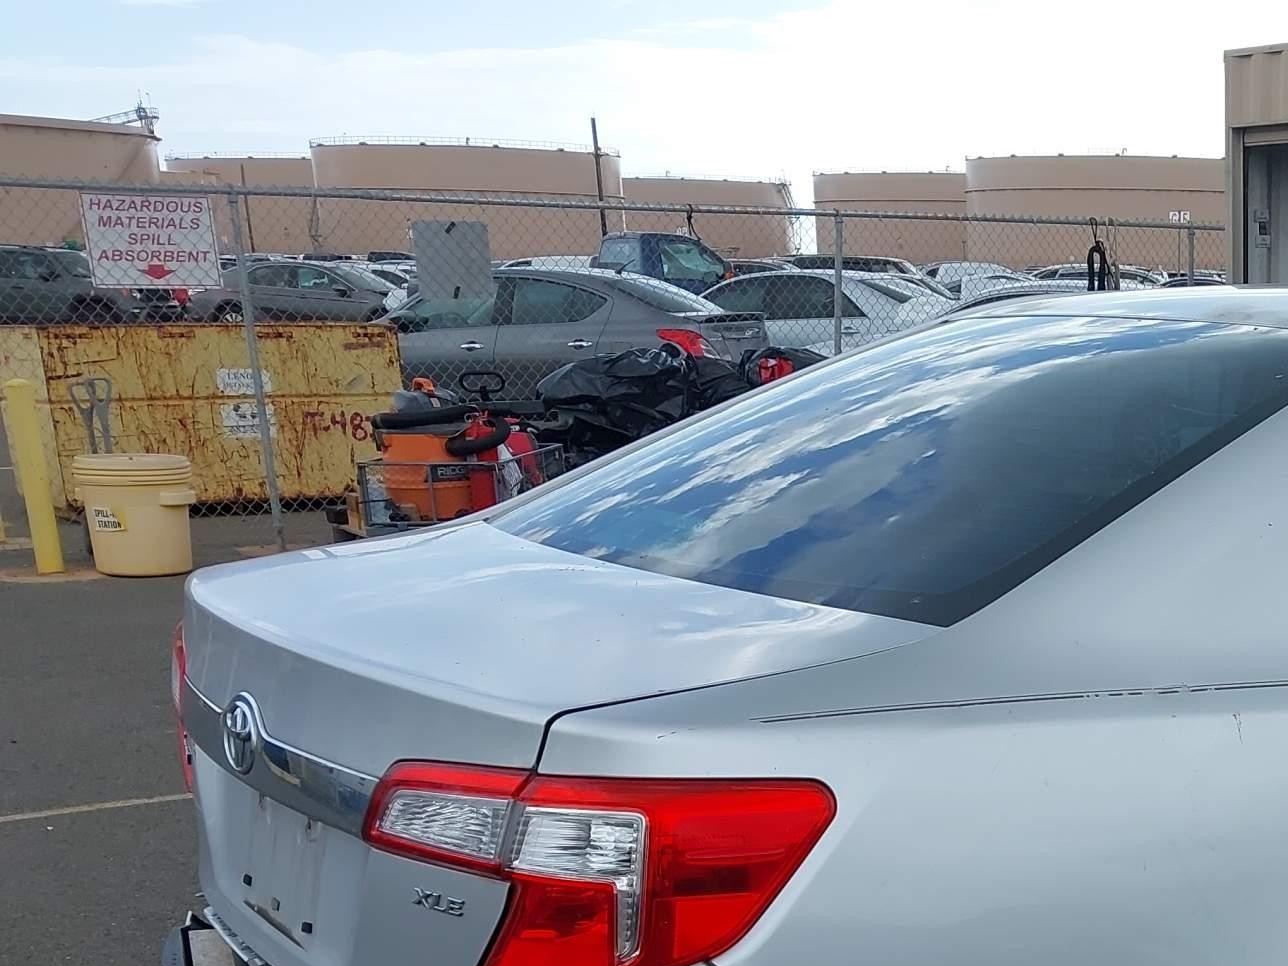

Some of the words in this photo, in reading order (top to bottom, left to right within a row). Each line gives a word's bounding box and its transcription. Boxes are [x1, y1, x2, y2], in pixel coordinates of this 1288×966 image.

[89, 198, 203, 214] HAZARDOUS
[97, 215, 201, 230] MATERIALS
[127, 232, 177, 246] SPILL
[98, 249, 211, 263] ABSORBENT
[97, 519, 122, 529] STATION
[411, 887, 465, 917] XLE
